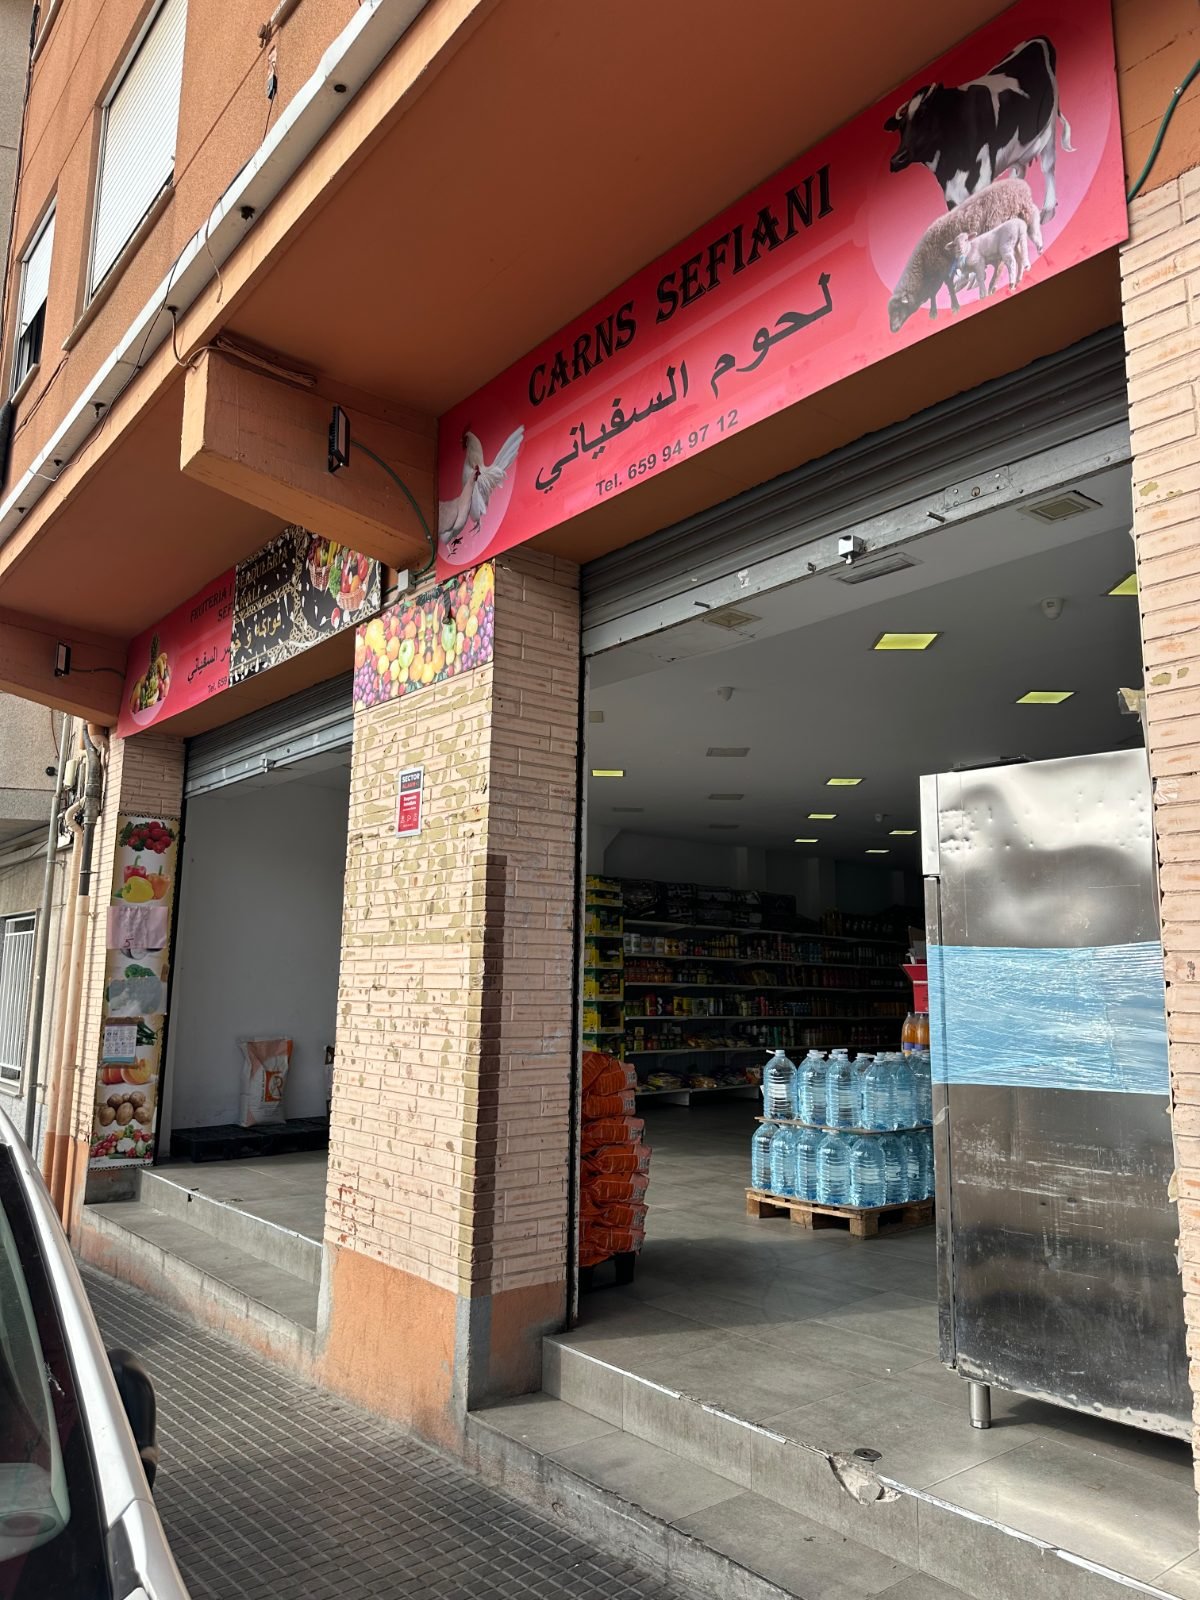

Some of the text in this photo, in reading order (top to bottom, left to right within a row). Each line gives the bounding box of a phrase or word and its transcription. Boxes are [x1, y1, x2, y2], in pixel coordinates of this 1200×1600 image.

[529, 164, 834, 407] CARNS SEFIANI
[535, 272, 833, 494] لحوم السفياني
[595, 408, 738, 496] Tel. 659 94 97 12
[401, 772, 420, 784] SECTOR
